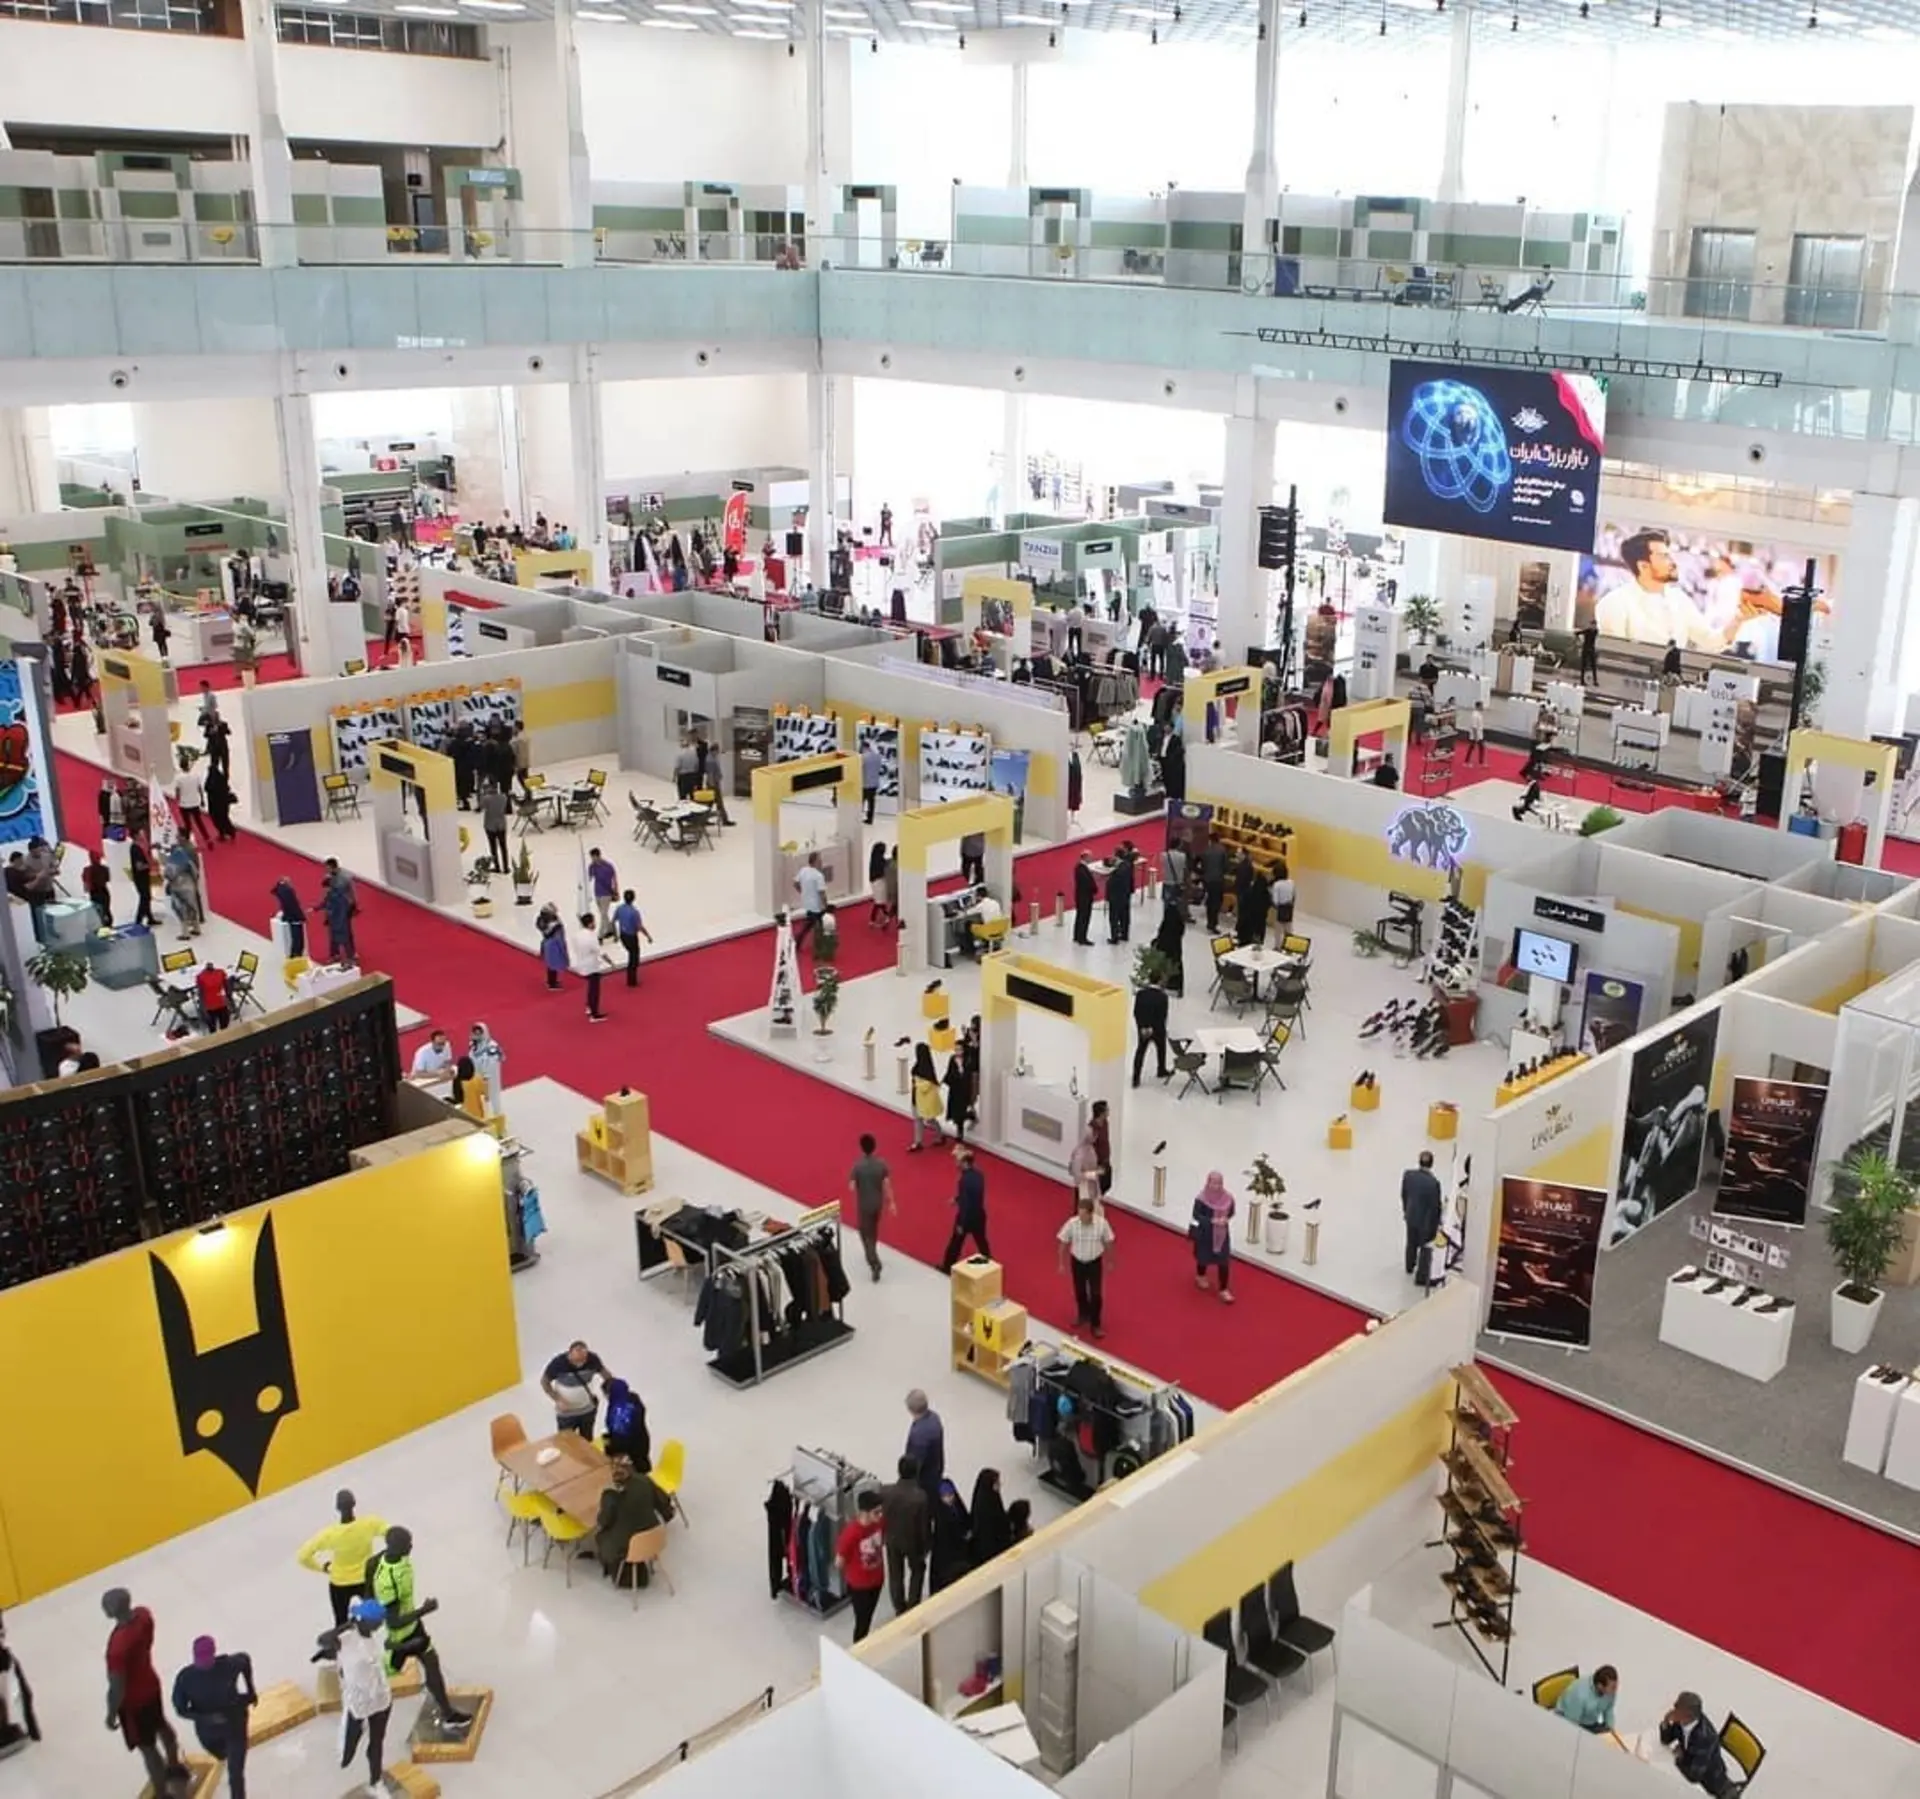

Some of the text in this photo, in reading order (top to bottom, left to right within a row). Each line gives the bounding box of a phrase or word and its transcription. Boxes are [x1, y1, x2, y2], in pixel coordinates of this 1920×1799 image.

[1509, 442, 1589, 470] بازار بزرگ ایران
